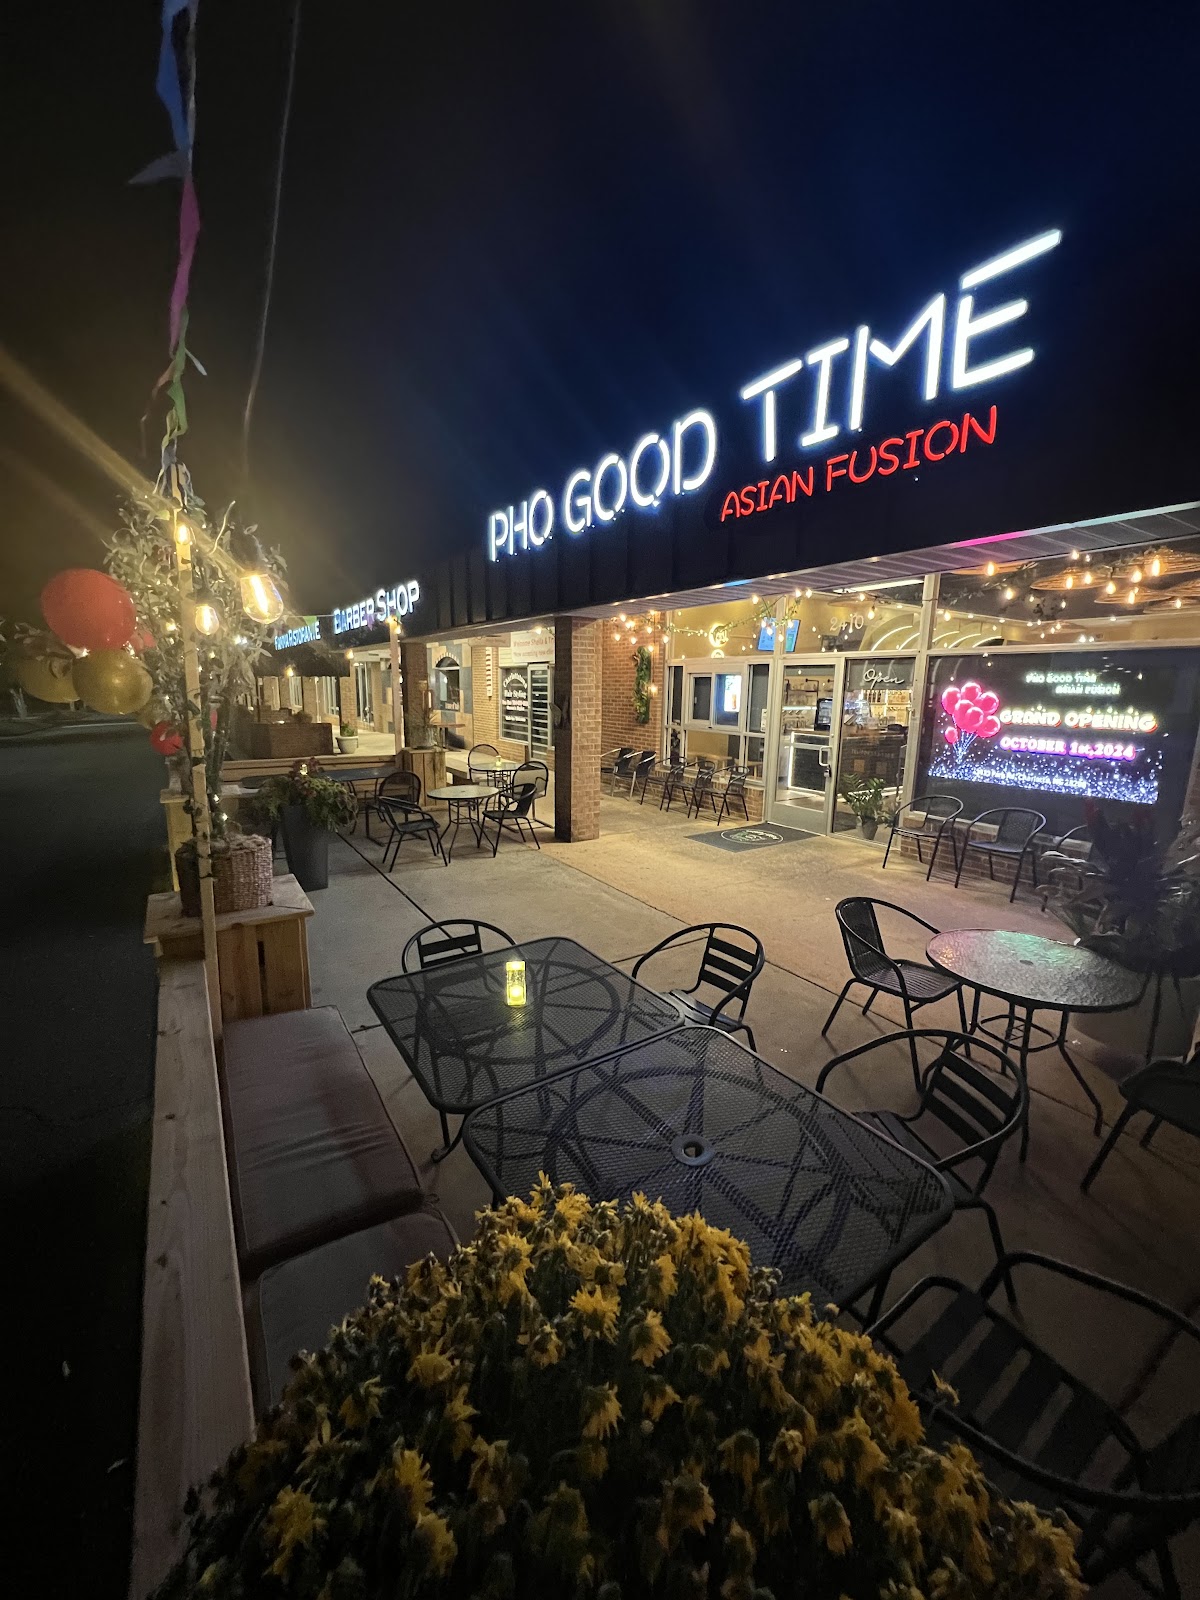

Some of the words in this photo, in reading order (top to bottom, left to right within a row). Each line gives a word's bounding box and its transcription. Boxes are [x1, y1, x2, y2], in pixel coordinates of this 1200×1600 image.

[488, 489, 553, 562] PHO
[563, 408, 718, 533] GOOD
[740, 228, 1063, 463] TIME
[719, 466, 815, 523] ASIAN
[825, 404, 998, 492] FUSION
[333, 597, 375, 635] BARBER
[377, 580, 420, 622] SHOP
[829, 612, 864, 632] 2410
[862, 667, 905, 690] Open
[999, 709, 1061, 727] GRAND
[1064, 710, 1158, 733] OPENING
[1000, 736, 1066, 755] OCTOBER
